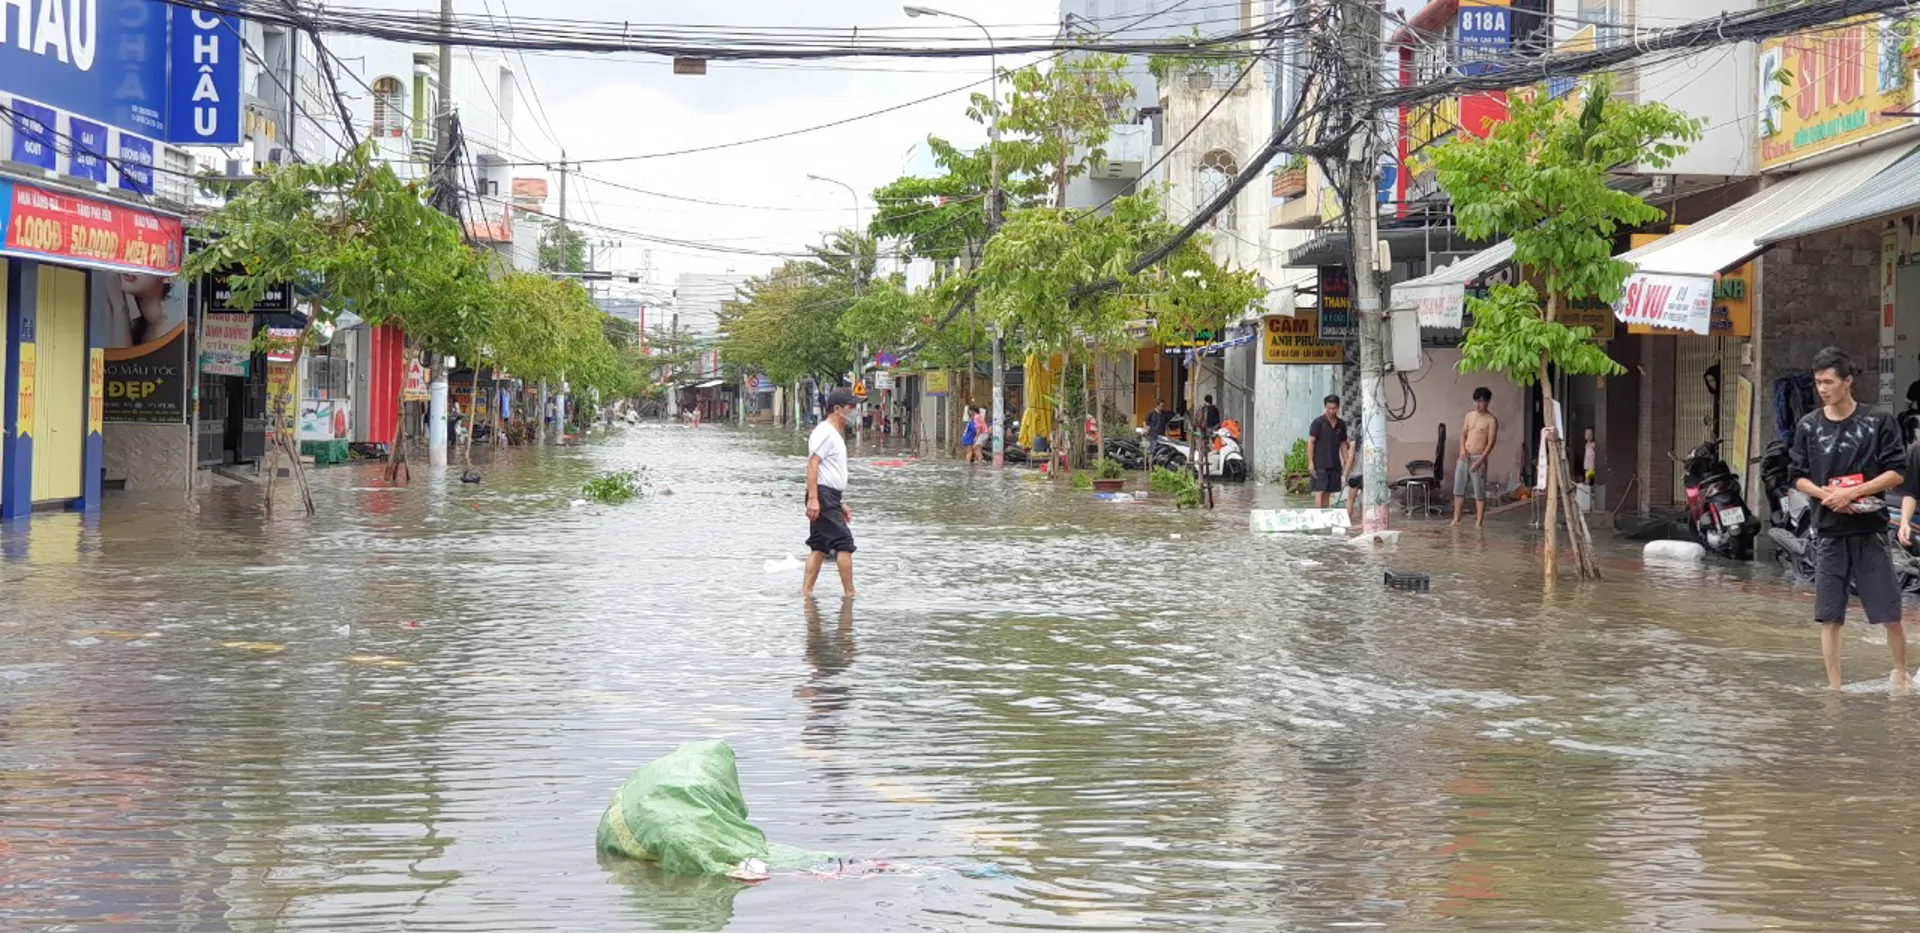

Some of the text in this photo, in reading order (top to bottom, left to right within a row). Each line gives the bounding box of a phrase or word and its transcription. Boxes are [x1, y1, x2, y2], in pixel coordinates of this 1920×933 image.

[1462, 11, 1506, 31] 818A
[1642, 284, 1672, 320] VUI
[1271, 335, 1293, 346] ANH
[153, 364, 178, 376] TÓC
